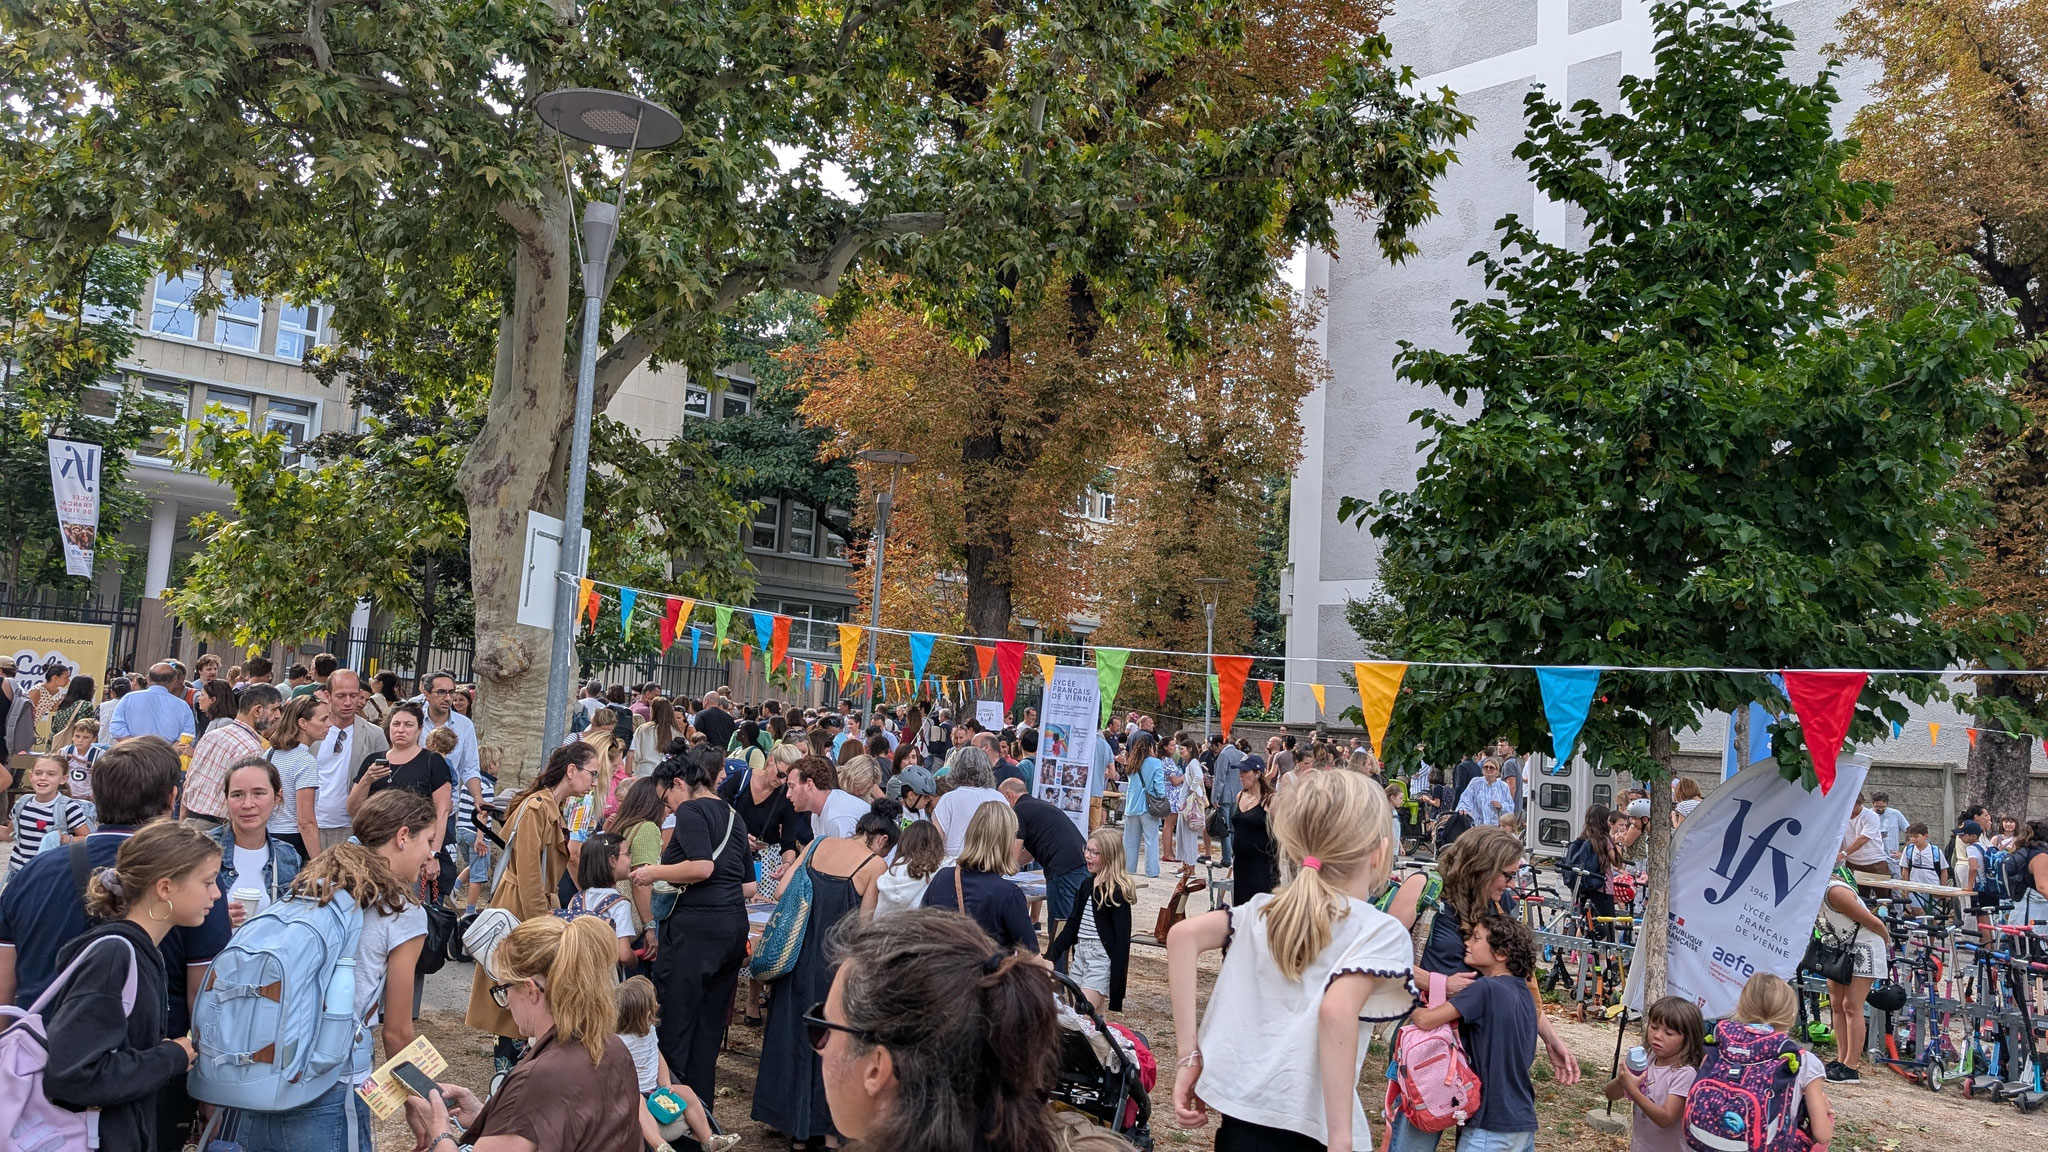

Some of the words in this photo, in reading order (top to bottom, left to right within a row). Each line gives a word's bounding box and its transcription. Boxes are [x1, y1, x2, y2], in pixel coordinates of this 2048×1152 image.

[0, 633, 94, 646] ww.latindancekids.com
[1052, 685, 1091, 696] FRANÇAIS
[1053, 678, 1077, 688] LYCÉE
[1051, 692, 1062, 700] DE
[1065, 694, 1093, 703] VIENNE
[1749, 885, 1770, 901] 1946
[1743, 902, 1771, 923] LYCÉE
[1668, 922, 1703, 947] ÉPUBLIQUE
[1738, 914, 1790, 946] FRANÇAIS
[1735, 924, 1749, 936] DE
[1753, 933, 1790, 958] VIENNE
[1712, 946, 1755, 978] aefe
